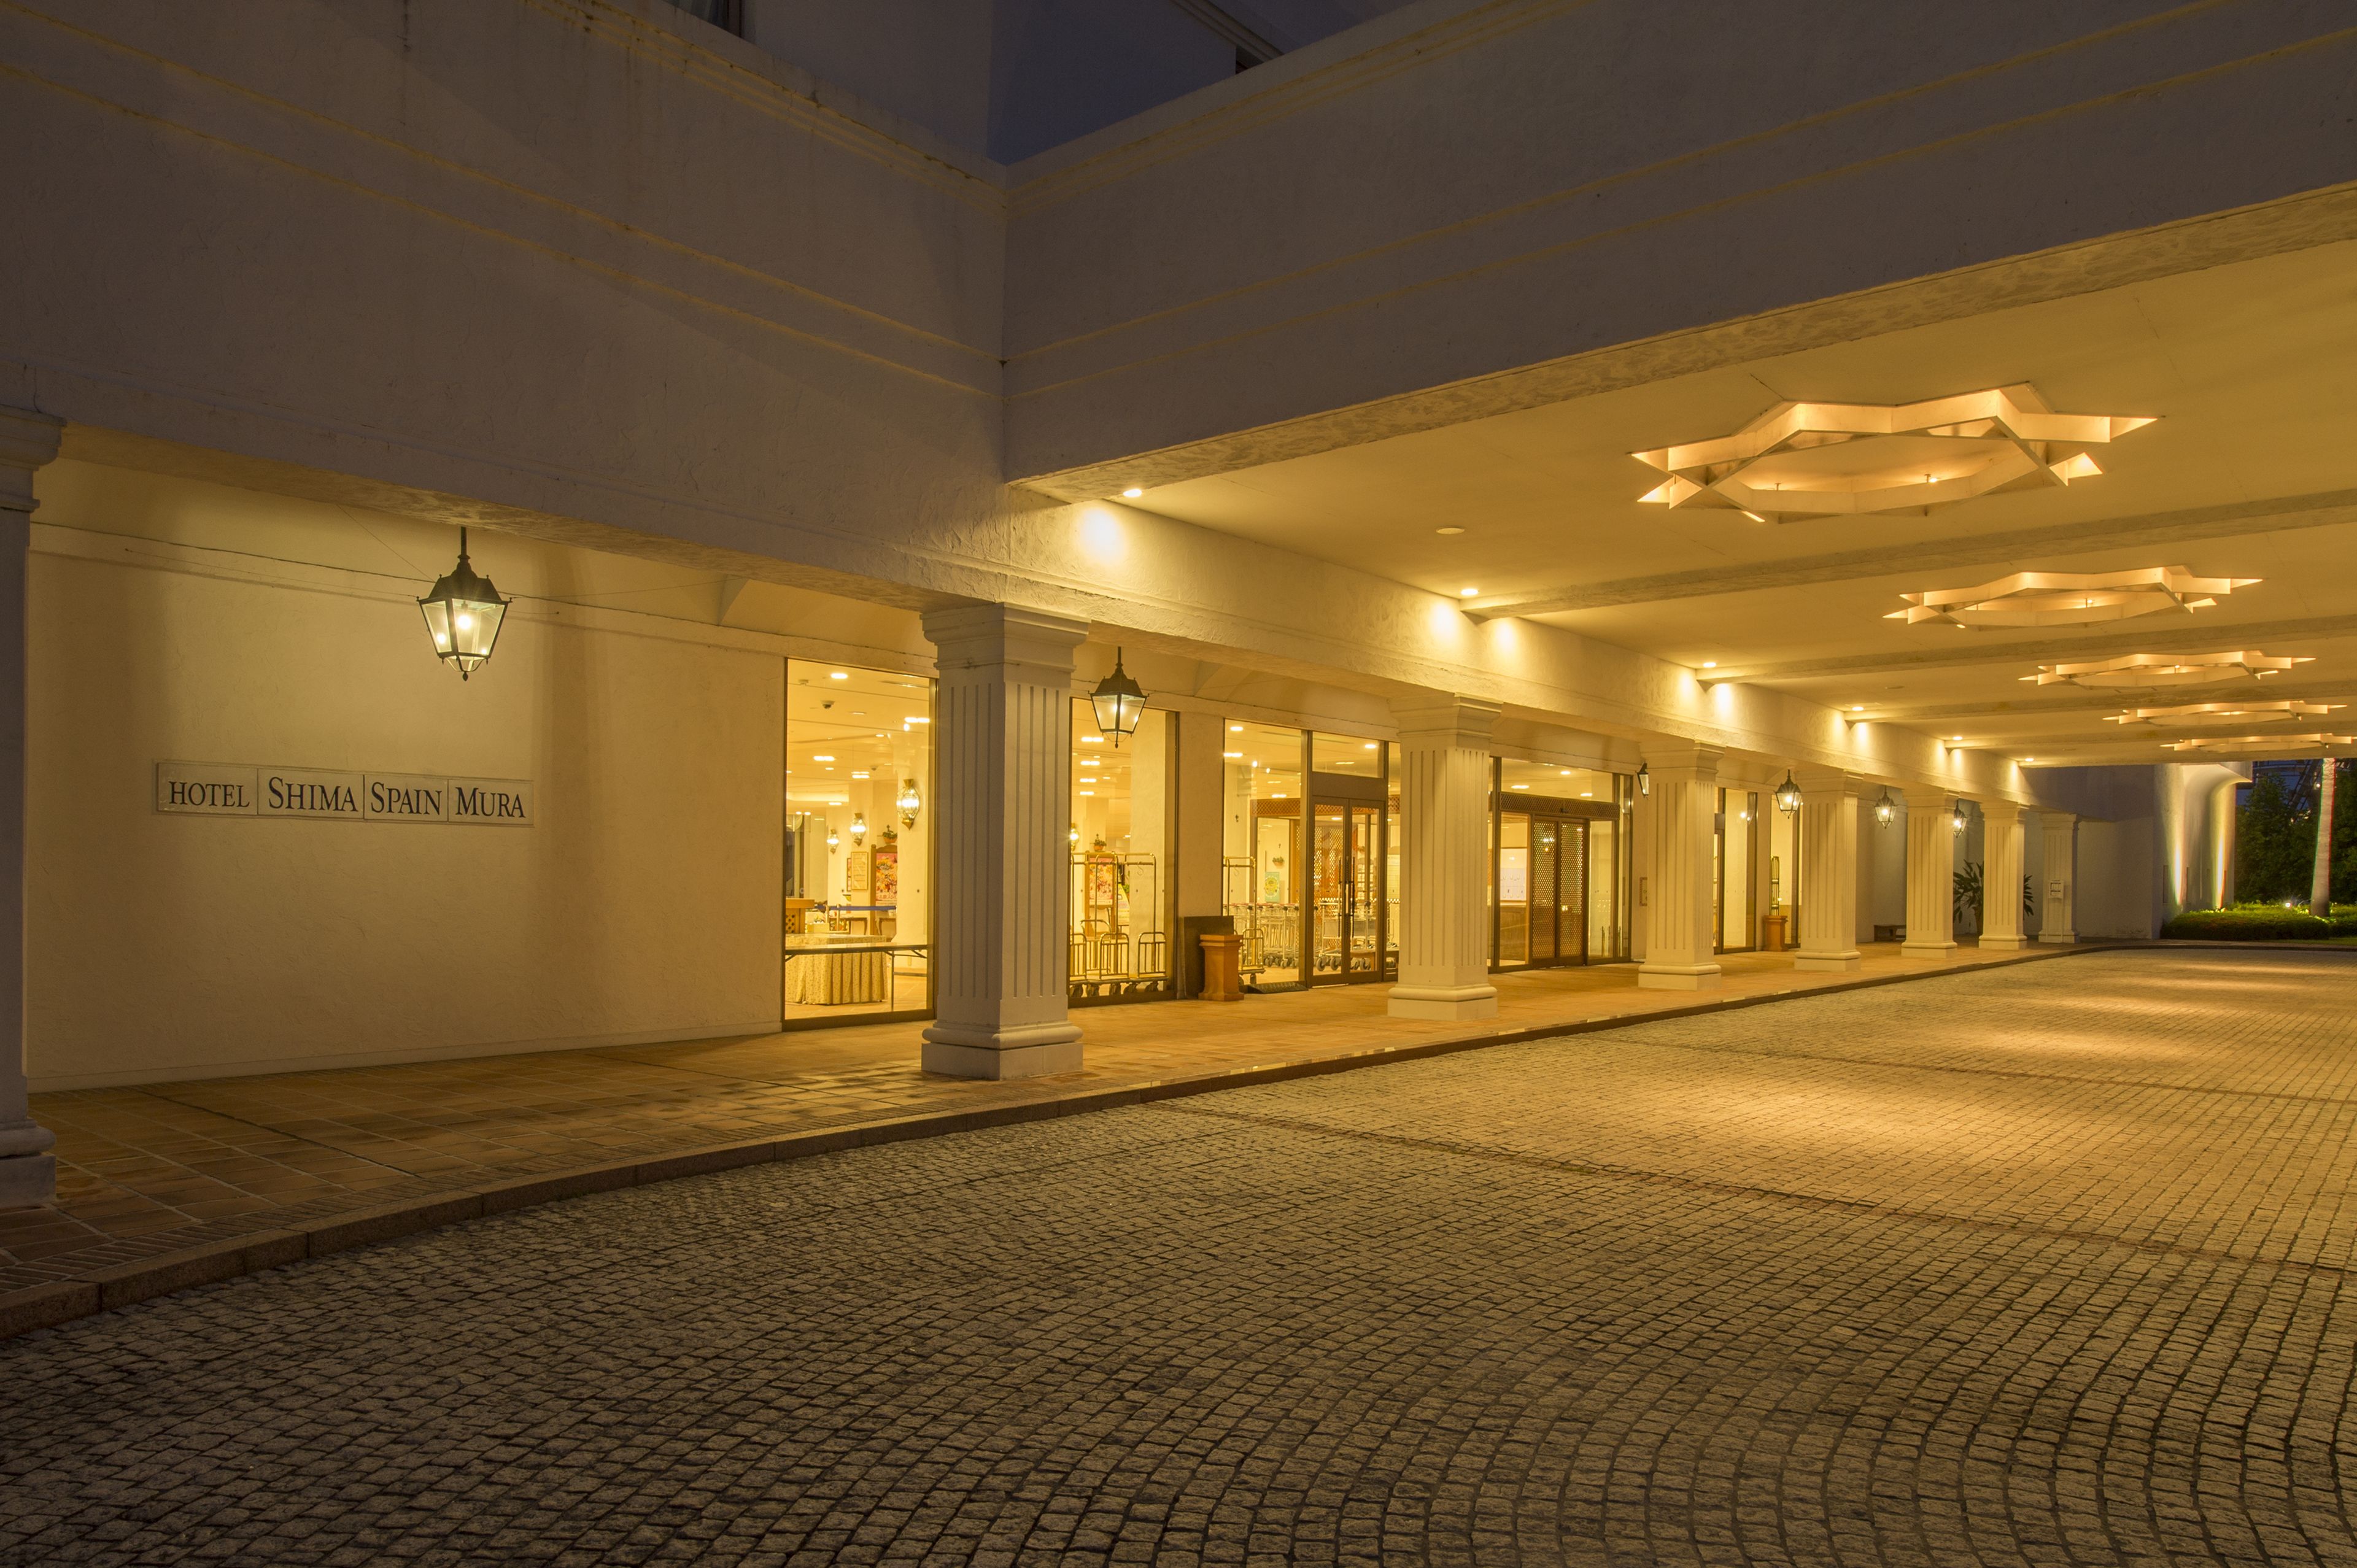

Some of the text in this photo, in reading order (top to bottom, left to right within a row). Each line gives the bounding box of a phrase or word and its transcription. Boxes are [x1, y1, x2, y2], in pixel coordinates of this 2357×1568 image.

[169, 776, 526, 818] HOTEL SHIMA SPAIN MURA
